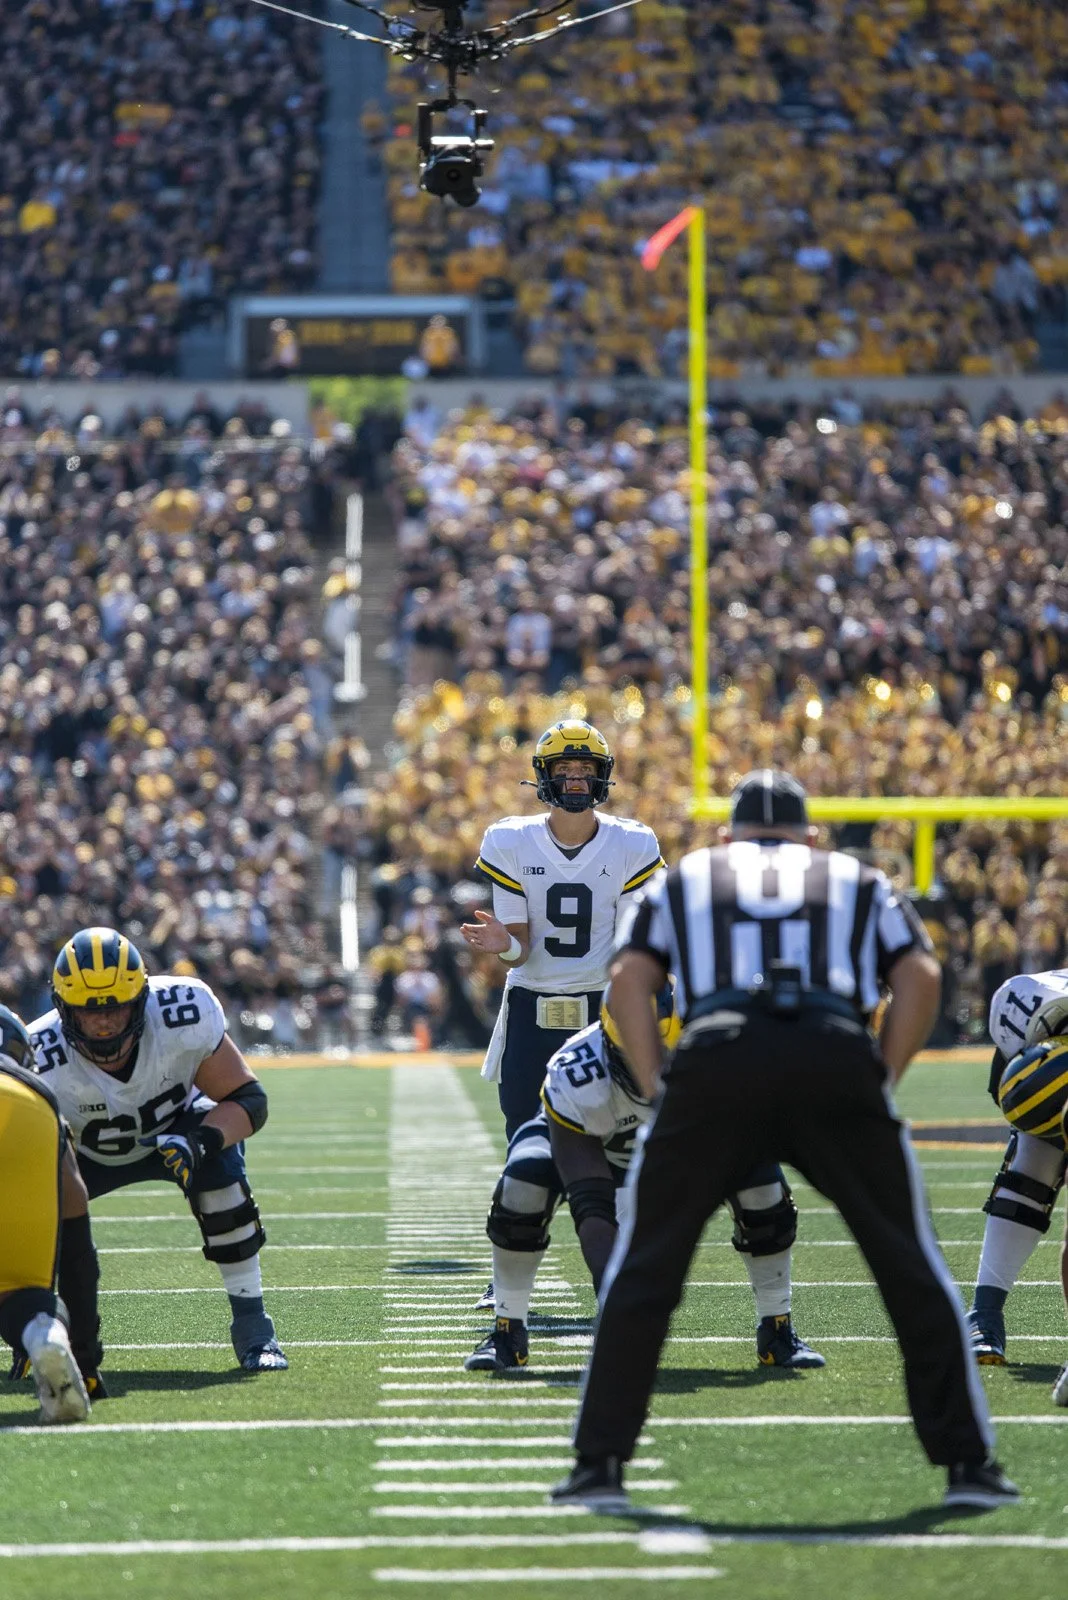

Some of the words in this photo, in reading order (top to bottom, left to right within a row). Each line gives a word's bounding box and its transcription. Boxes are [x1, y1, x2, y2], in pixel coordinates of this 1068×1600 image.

[545, 883, 592, 958] 9
[156, 984, 201, 1029] 65
[556, 1041, 607, 1089] 55
